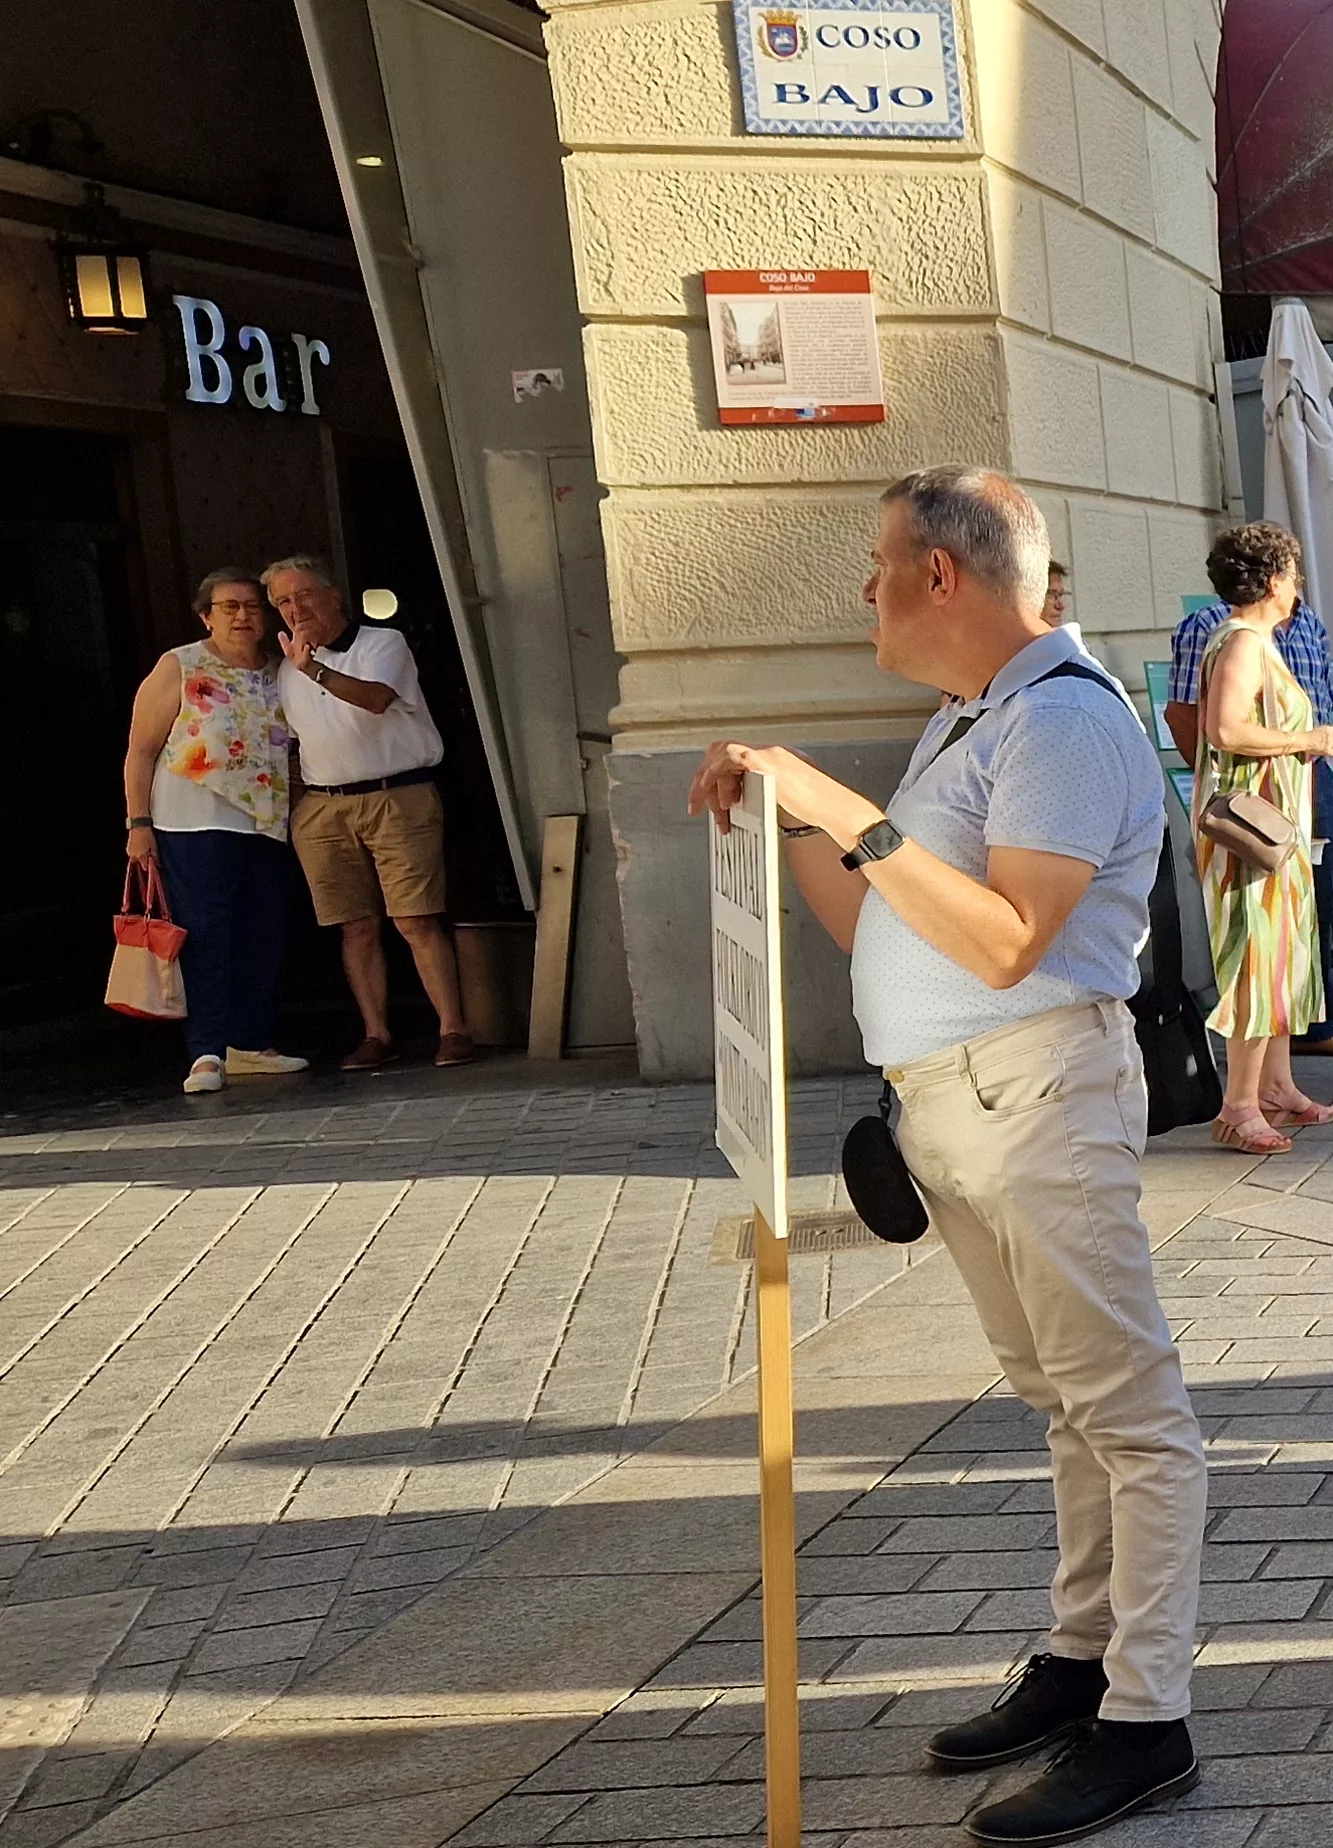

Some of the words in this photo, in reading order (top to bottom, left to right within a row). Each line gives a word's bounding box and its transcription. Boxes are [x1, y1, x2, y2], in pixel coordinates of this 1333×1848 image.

[816, 24, 921, 50] COSO
[772, 82, 934, 114] BAJO
[759, 271, 786, 283] COSO
[789, 271, 816, 283] BAJO
[172, 294, 330, 415] Bar
[714, 824, 763, 922] FESTIVAL
